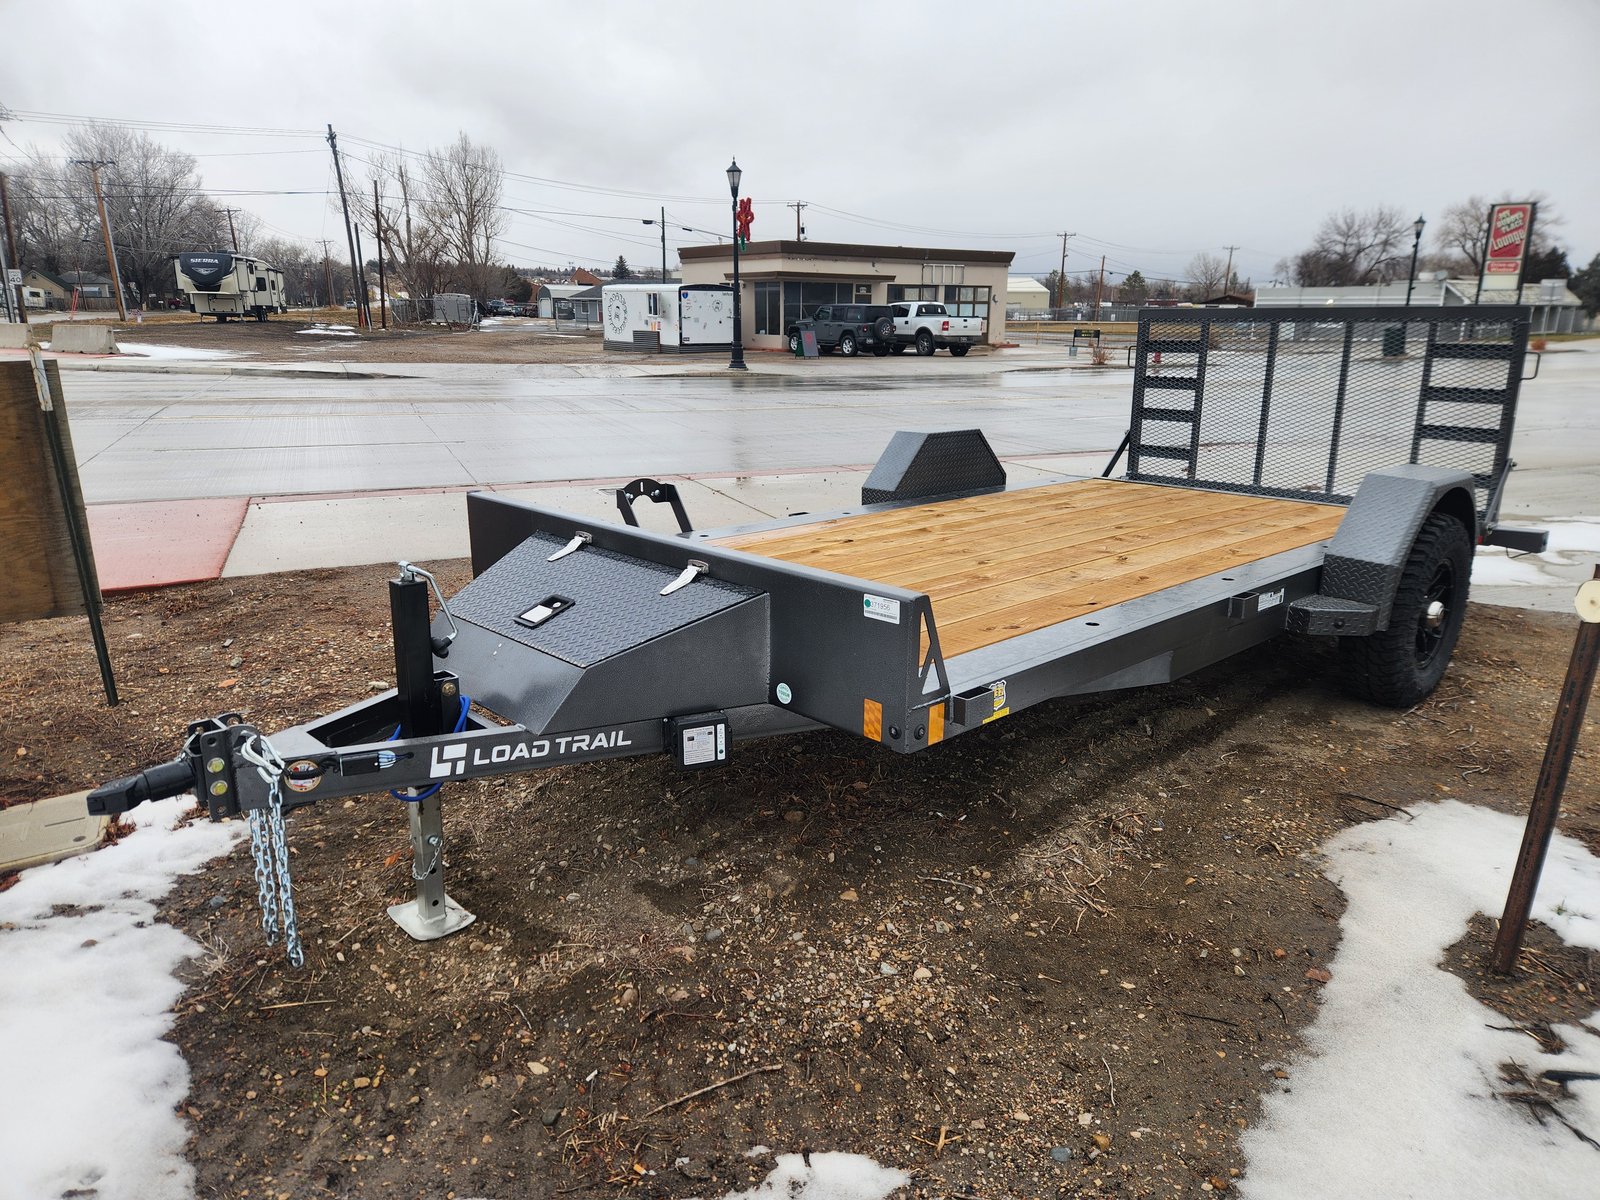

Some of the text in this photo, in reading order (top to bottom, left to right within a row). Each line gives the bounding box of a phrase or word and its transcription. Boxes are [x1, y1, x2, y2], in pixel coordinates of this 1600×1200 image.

[1492, 230, 1526, 250] Lounge
[473, 730, 632, 766] LOAD TRAIL
